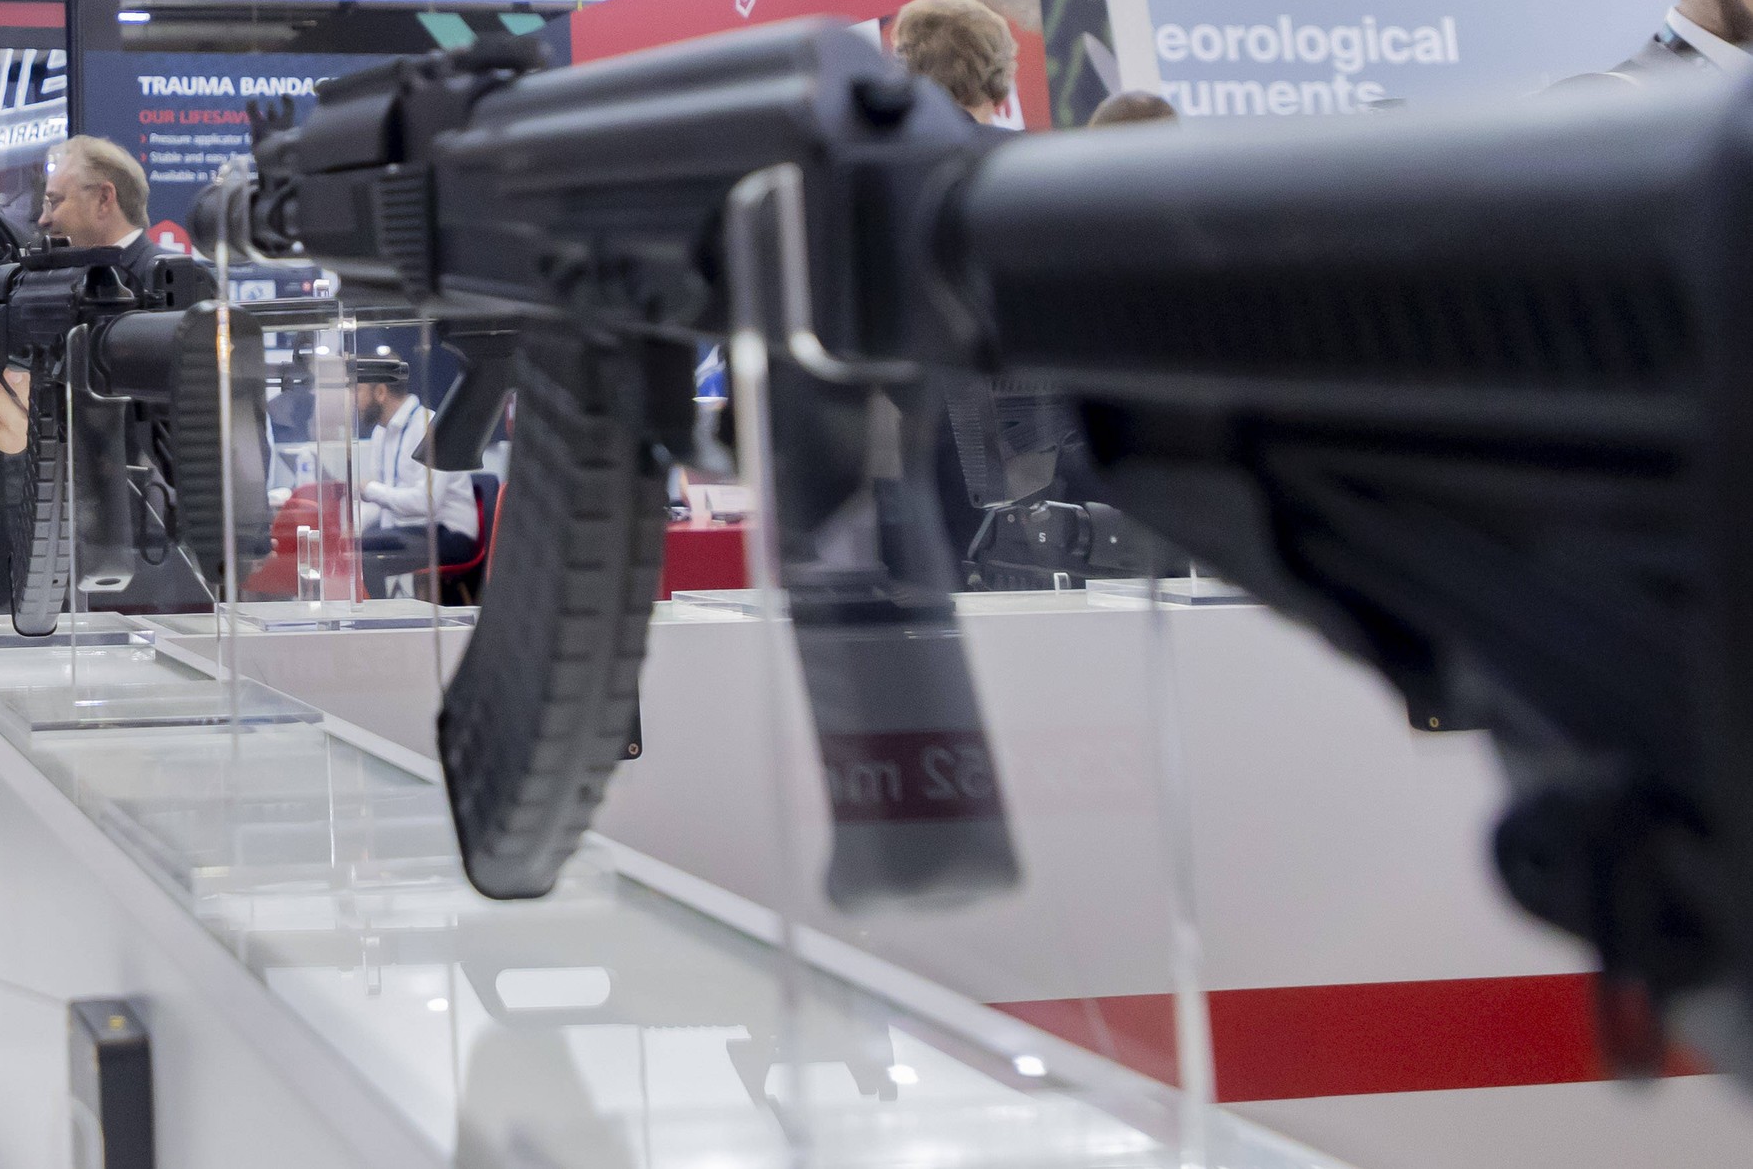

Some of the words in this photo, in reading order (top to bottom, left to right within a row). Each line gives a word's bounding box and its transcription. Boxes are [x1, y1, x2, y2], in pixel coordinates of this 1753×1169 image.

[1156, 13, 1460, 74] eorological
[138, 76, 236, 96] TRAUMA
[240, 77, 340, 96] BANDA
[139, 110, 175, 124] OUR
[179, 110, 251, 125] LIFESAV
